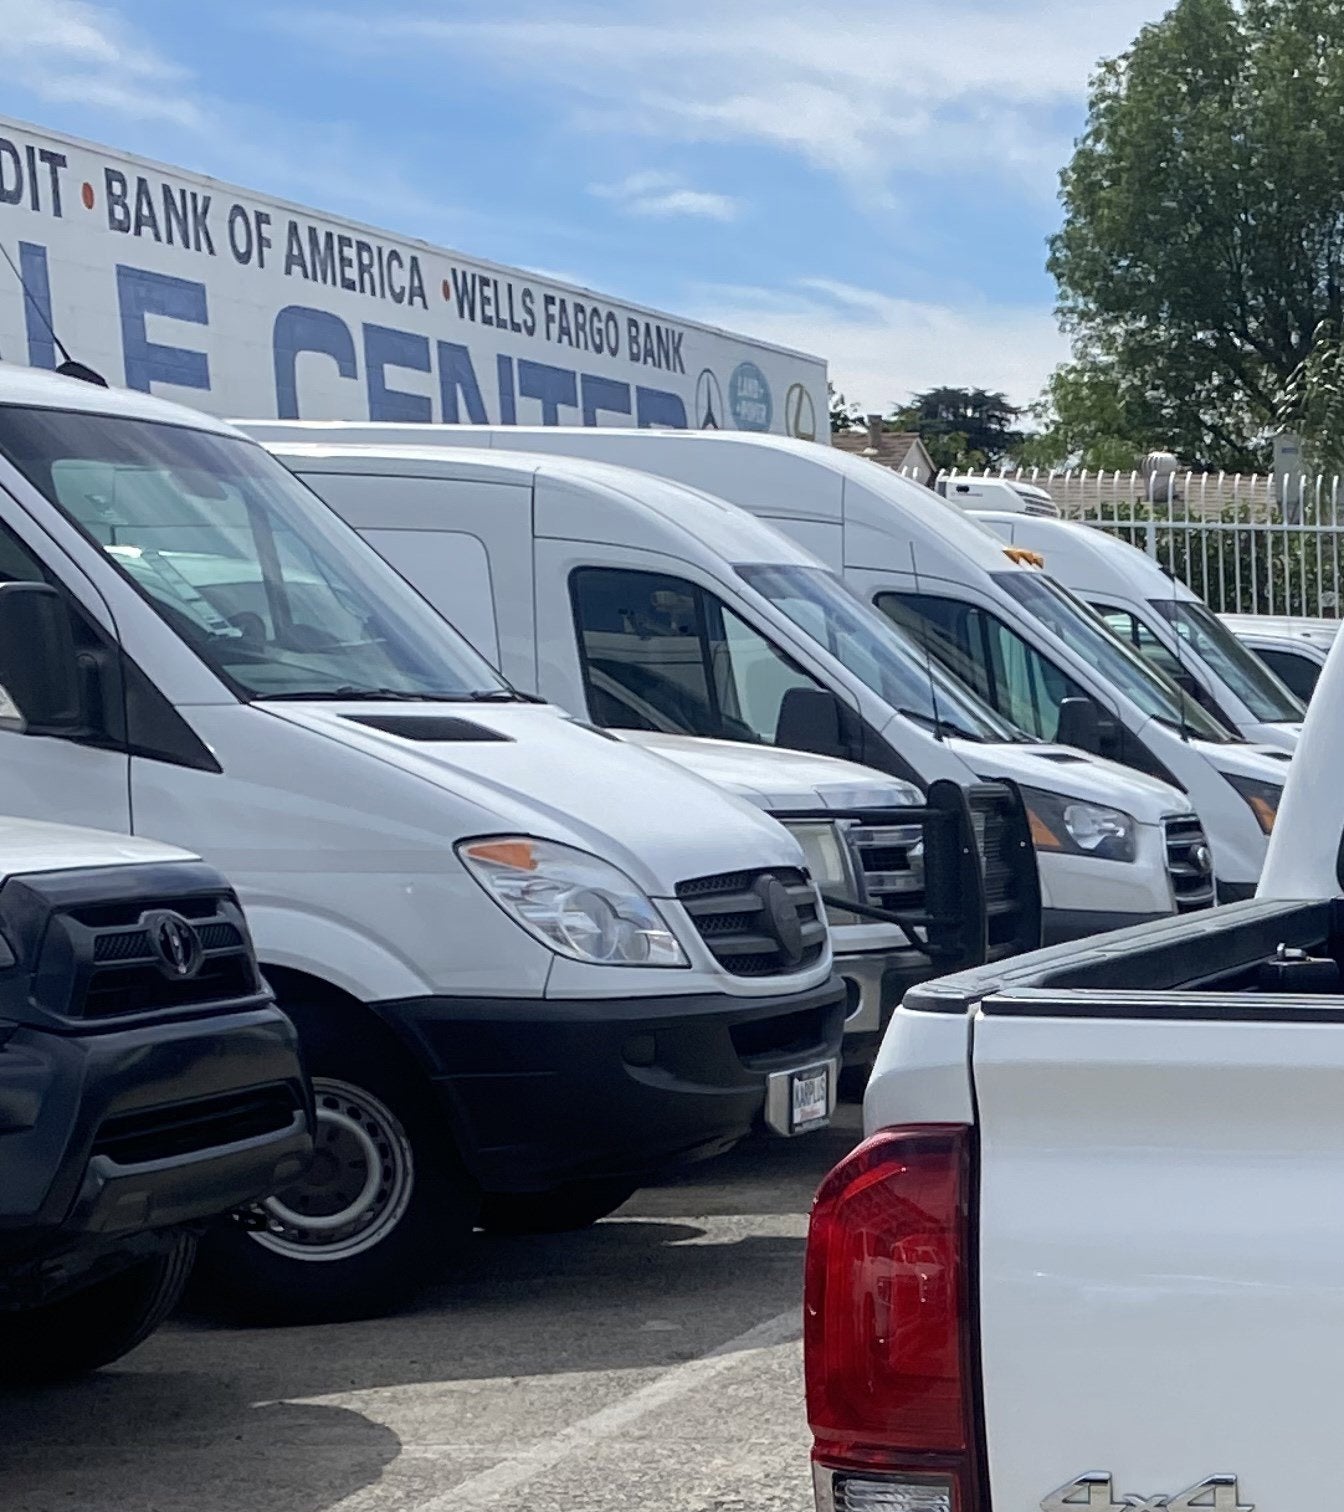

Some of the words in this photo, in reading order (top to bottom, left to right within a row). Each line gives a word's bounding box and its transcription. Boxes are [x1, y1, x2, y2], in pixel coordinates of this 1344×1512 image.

[0, 137, 67, 218] DIT
[104, 167, 217, 256] BANK
[227, 203, 272, 269] OF
[284, 220, 429, 310] AMERICA
[451, 267, 536, 338] WELLS
[543, 293, 620, 358] FARGO
[628, 317, 686, 375] BANK
